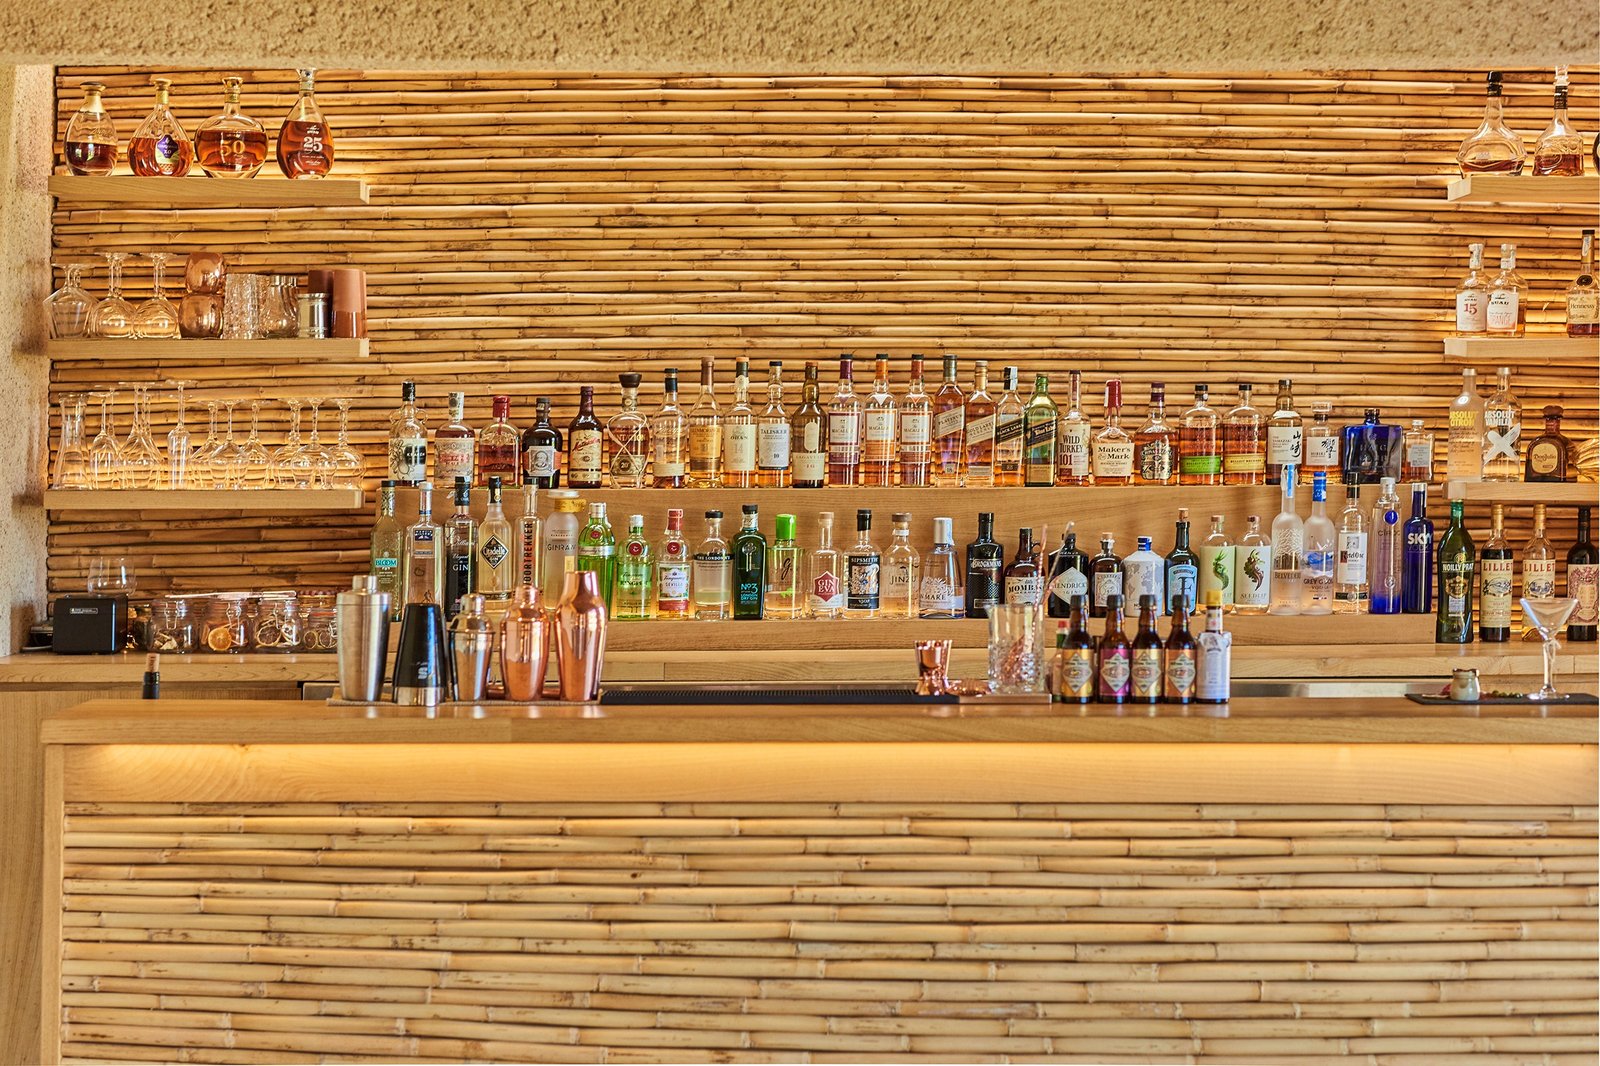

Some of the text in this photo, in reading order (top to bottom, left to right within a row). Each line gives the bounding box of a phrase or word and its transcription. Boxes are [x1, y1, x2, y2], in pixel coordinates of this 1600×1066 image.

[221, 140, 246, 157] 50
[303, 136, 323, 152] 25
[1463, 303, 1478, 315] 15
[1449, 410, 1478, 419] ABSOLUT
[1484, 410, 1515, 419] ABSOLUT
[1062, 434, 1080, 444] WILD
[1059, 443, 1083, 454] TURKEY
[1059, 454, 1073, 466] 101
[1408, 533, 1432, 544] SKYY
[971, 558, 1002, 568] BROCKMANS
[1442, 563, 1462, 571] NOILLY
[890, 576, 917, 585] JINZU
[1008, 584, 1042, 594] MOMBS
